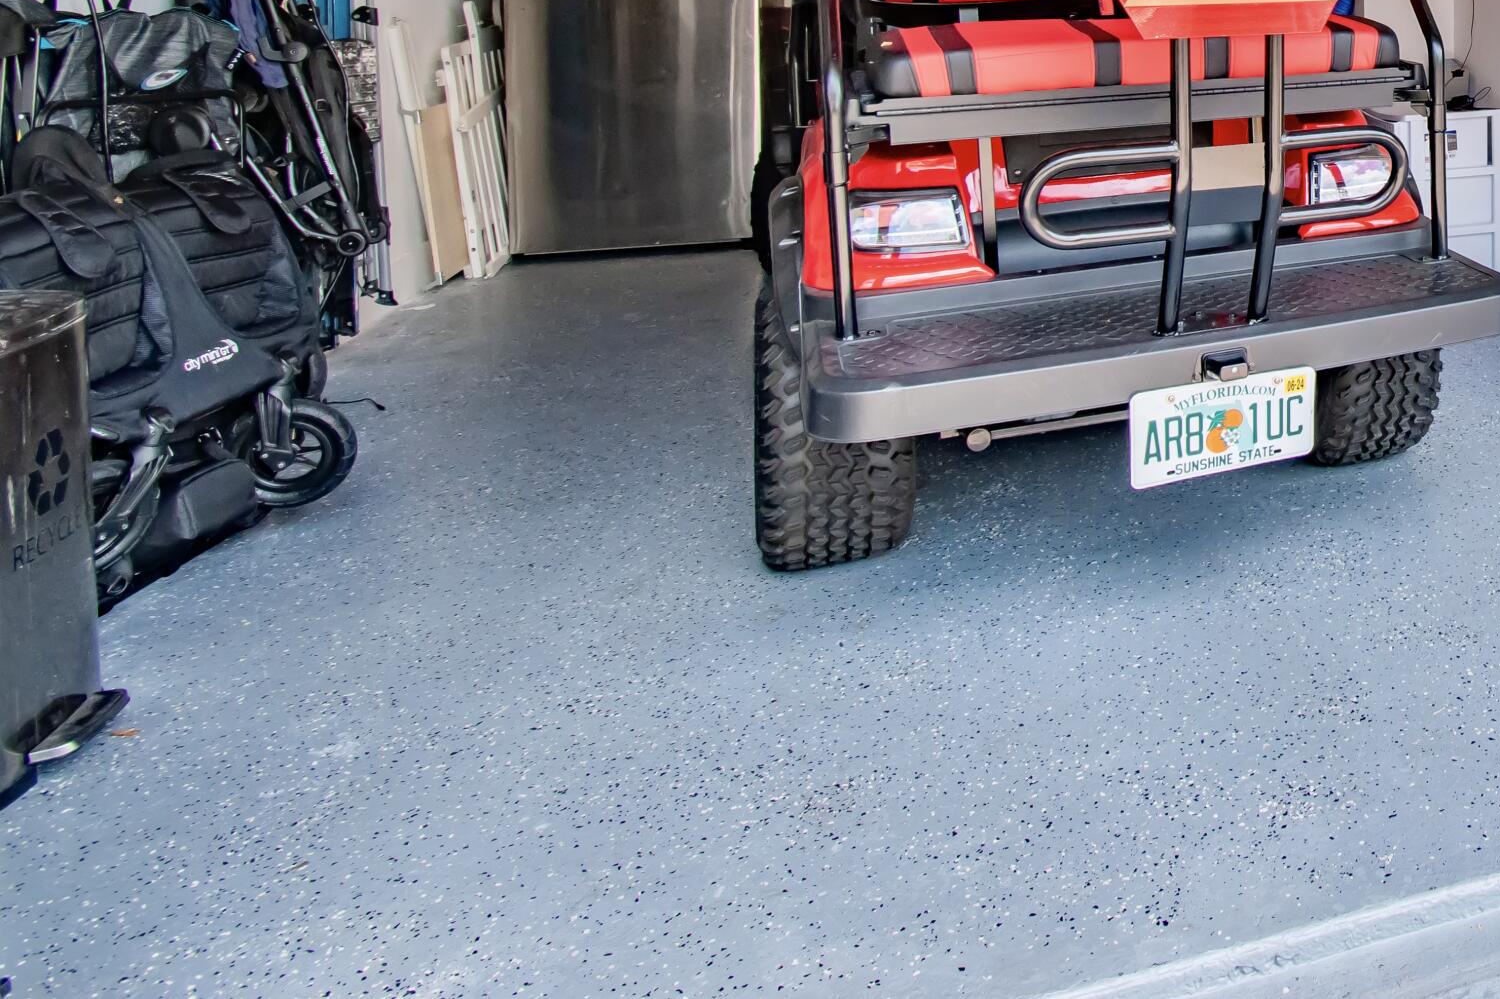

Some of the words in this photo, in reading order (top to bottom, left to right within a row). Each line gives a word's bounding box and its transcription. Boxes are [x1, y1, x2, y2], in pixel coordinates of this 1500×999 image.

[1173, 384, 1276, 412] MYFLORIDA.COM
[1144, 412, 1204, 465] AR8
[1249, 395, 1304, 445] 1UC
[1175, 453, 1233, 475] SUNSHINE
[1239, 445, 1275, 463] STATE
